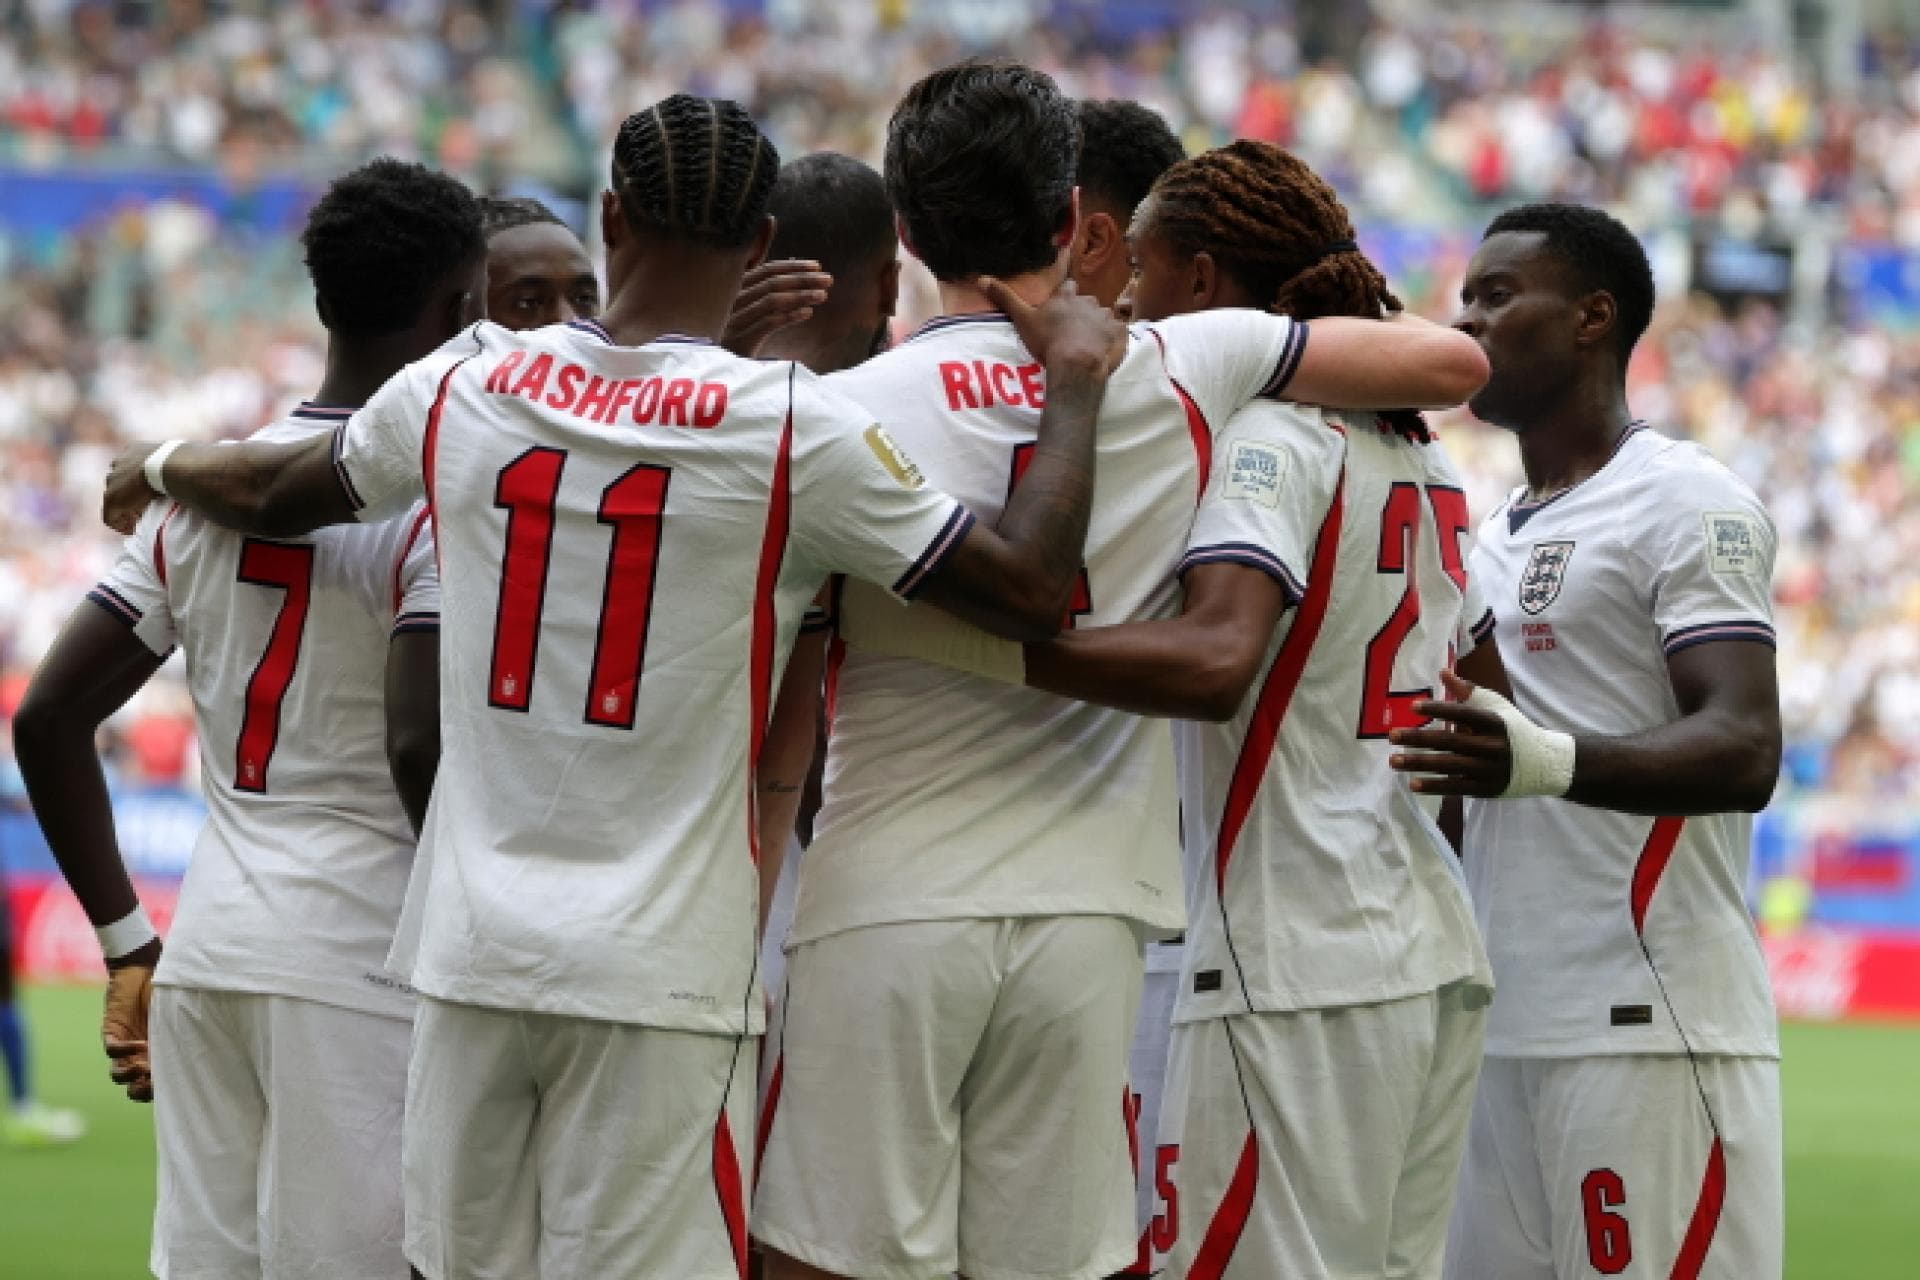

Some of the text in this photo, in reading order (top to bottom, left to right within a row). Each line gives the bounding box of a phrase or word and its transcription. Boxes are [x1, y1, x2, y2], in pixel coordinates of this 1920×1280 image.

[485, 351, 728, 429] RASHFORD
[938, 360, 1045, 411] RICE
[488, 444, 672, 730] 11
[233, 537, 316, 793] 7
[1581, 1168, 1632, 1274] 6
